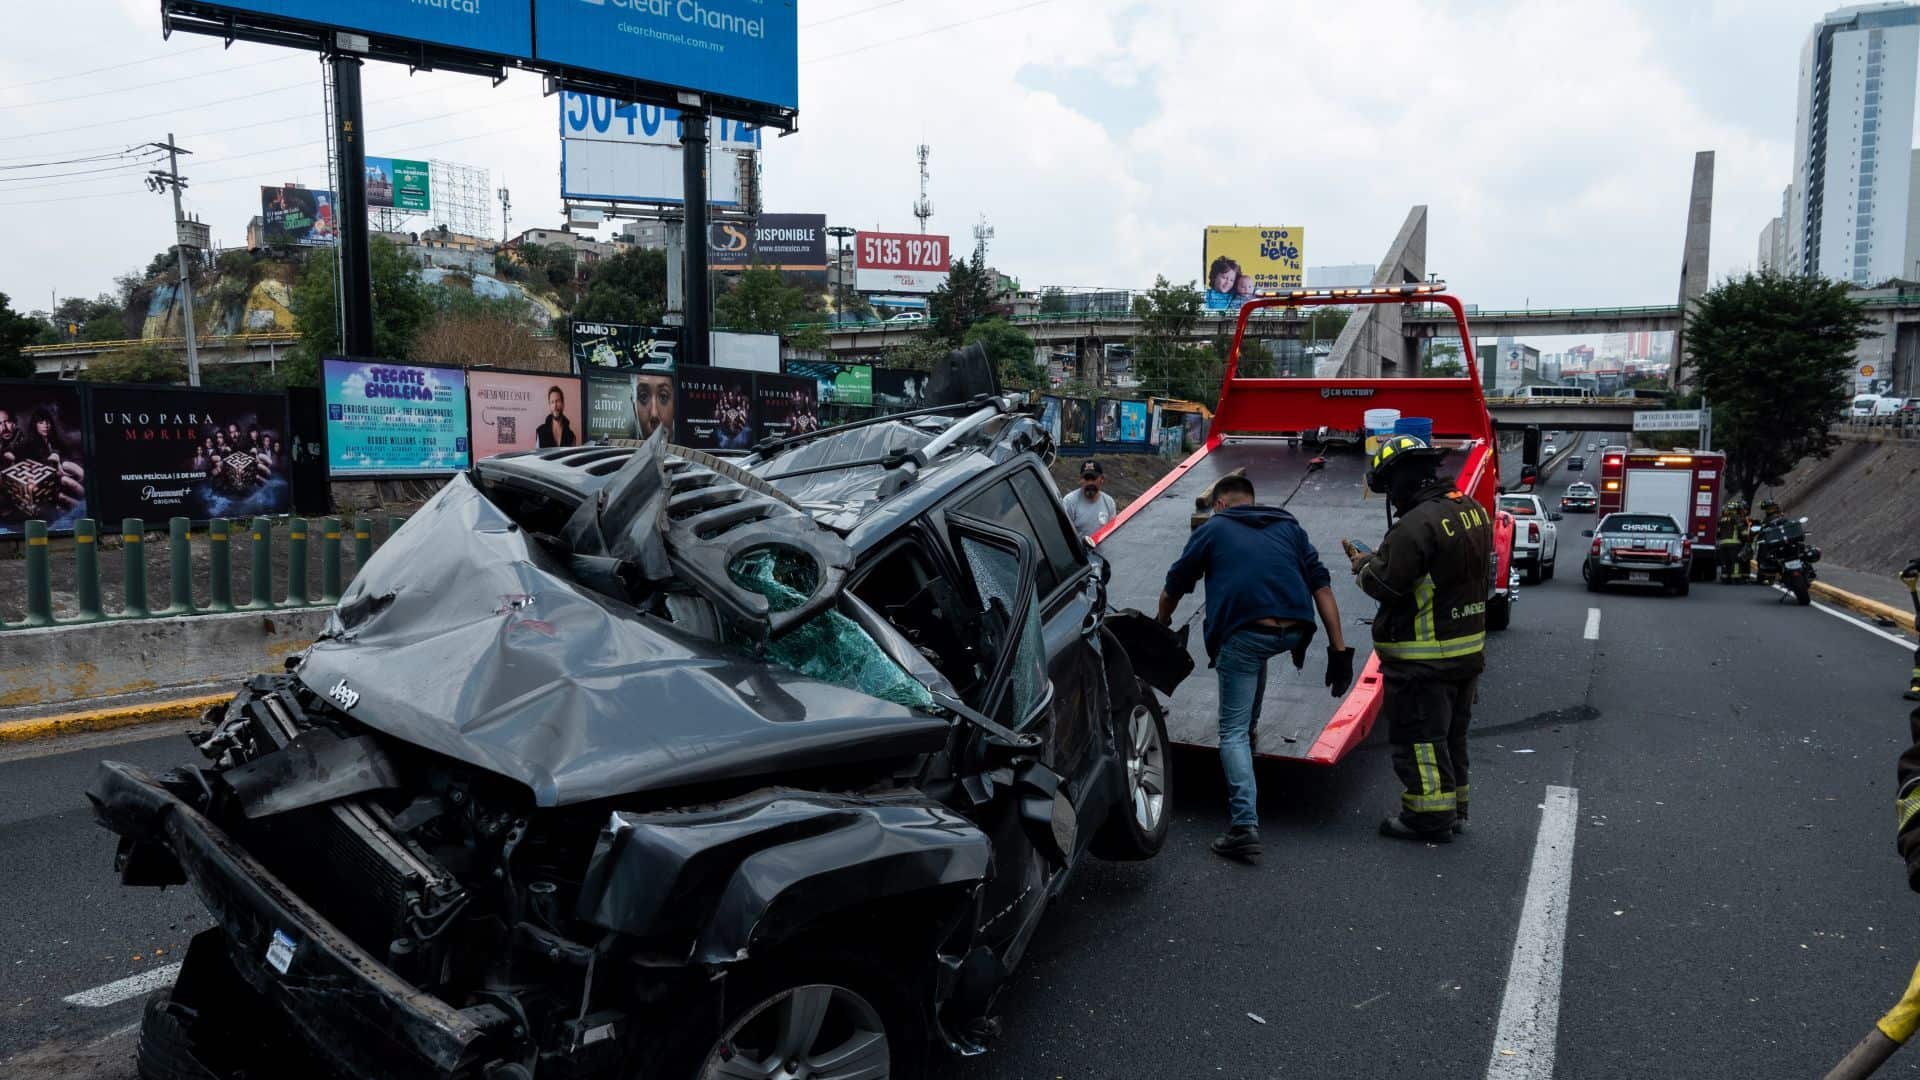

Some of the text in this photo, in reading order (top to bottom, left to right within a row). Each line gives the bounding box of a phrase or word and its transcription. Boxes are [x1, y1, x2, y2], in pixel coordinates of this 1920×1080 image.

[677, 0, 765, 39] Channel
[617, 21, 725, 53] clearchannel.com.mx
[1260, 230, 1288, 240] expo
[865, 238, 942, 269] 5135 1920
[1260, 241, 1299, 260] bebé
[1283, 258, 1289, 266] y
[1254, 281, 1279, 289] JUNIO
[1281, 274, 1302, 282] WTC
[575, 324, 618, 337] JUNIO 9
[370, 367, 425, 386] TECATE
[364, 382, 434, 401] EMBLEMA
[594, 399, 624, 412] amor
[104, 413, 214, 425] UNO PARA
[329, 678, 360, 711] Jeep
